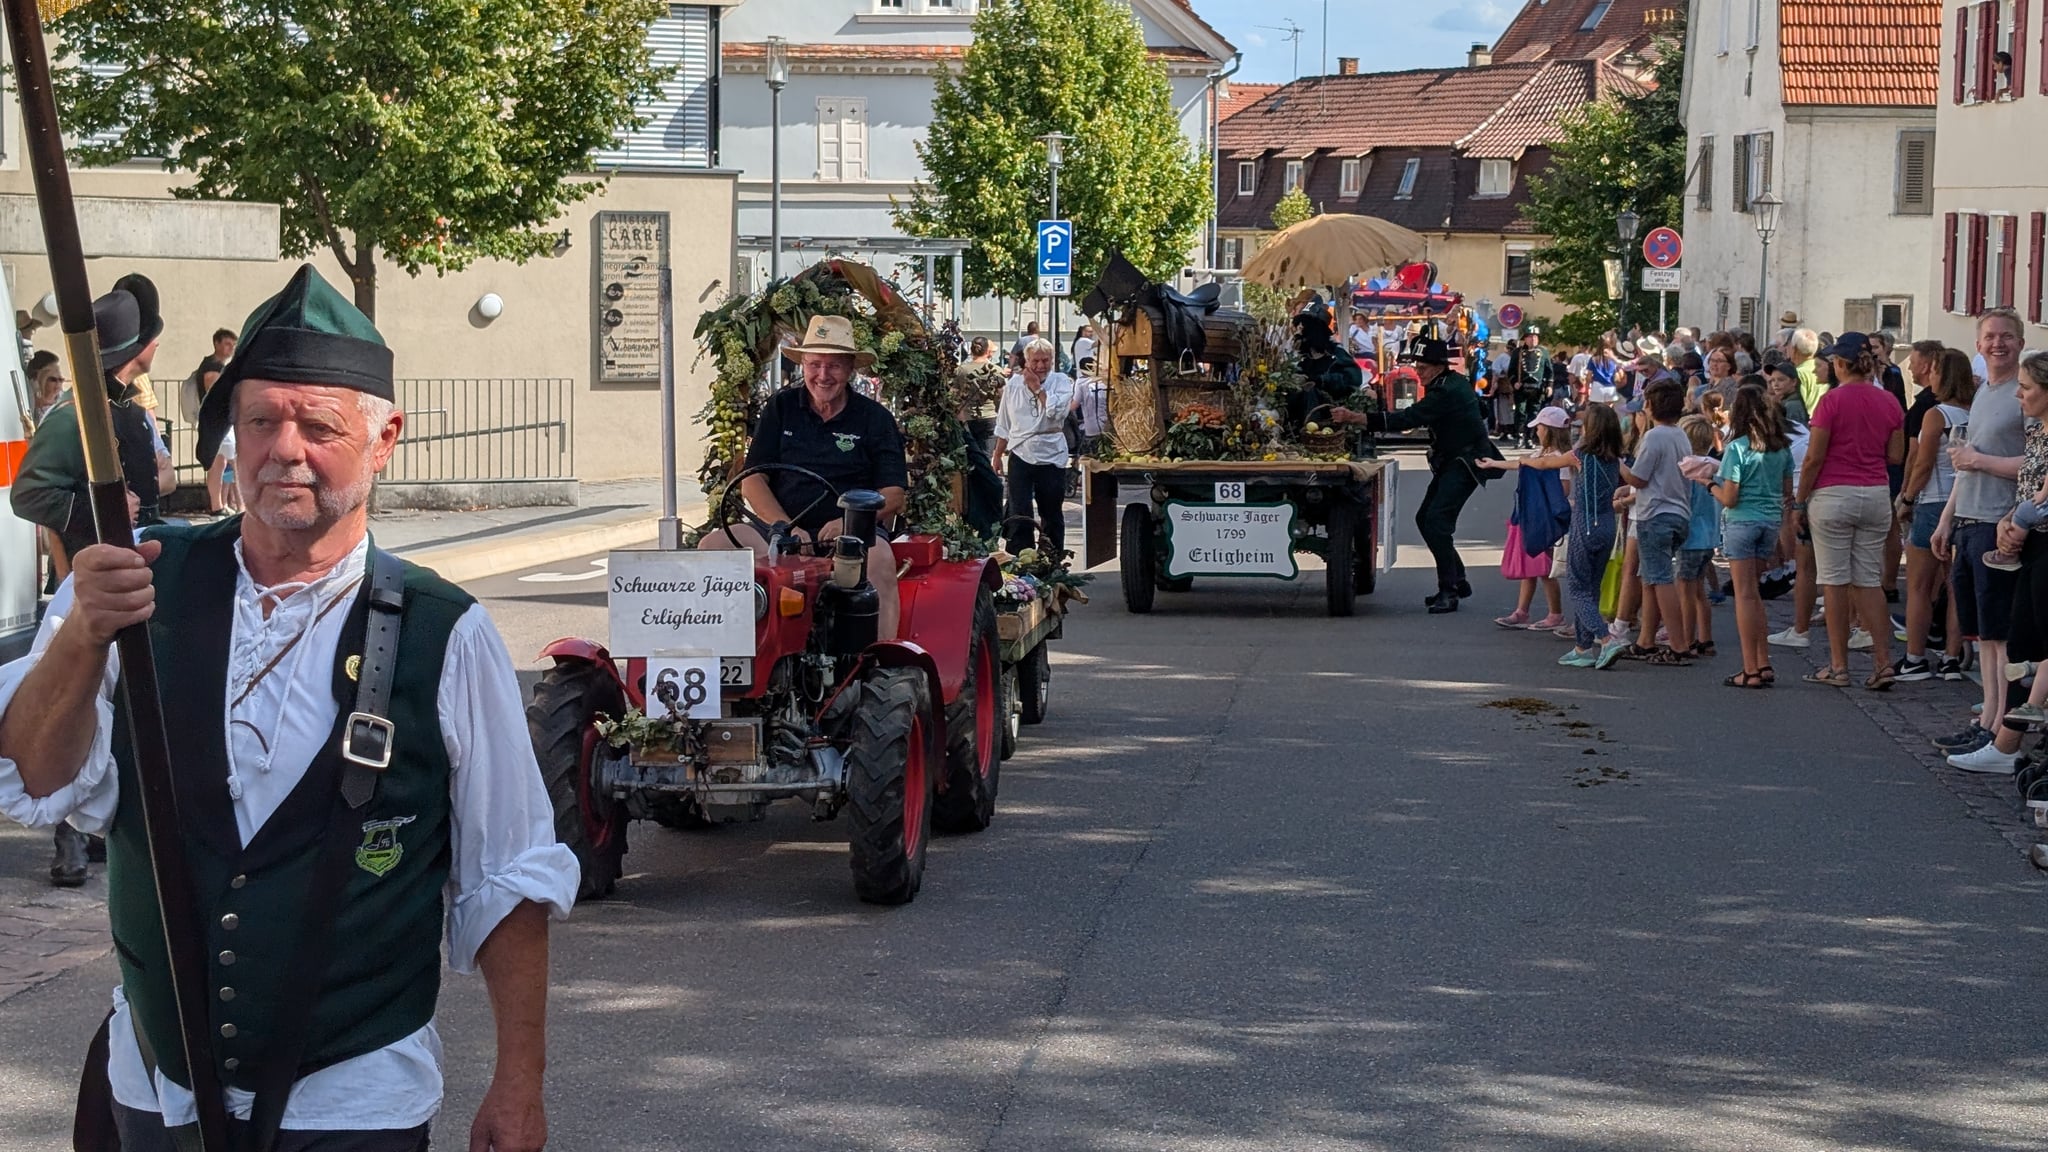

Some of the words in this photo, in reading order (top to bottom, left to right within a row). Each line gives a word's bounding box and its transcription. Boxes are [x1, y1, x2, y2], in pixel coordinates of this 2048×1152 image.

[609, 228, 662, 241] CARRE
[1047, 233, 1061, 253] P
[1219, 483, 1241, 499] 68
[1181, 510, 1239, 523] Schwarze
[1243, 510, 1280, 524] Jäger
[1216, 528, 1246, 539] 1799
[1189, 548, 1274, 566] Erligheim
[612, 576, 697, 593] Schwarze
[701, 575, 752, 598] Jäger
[641, 608, 724, 630] Erligheim
[656, 667, 707, 706] 68
